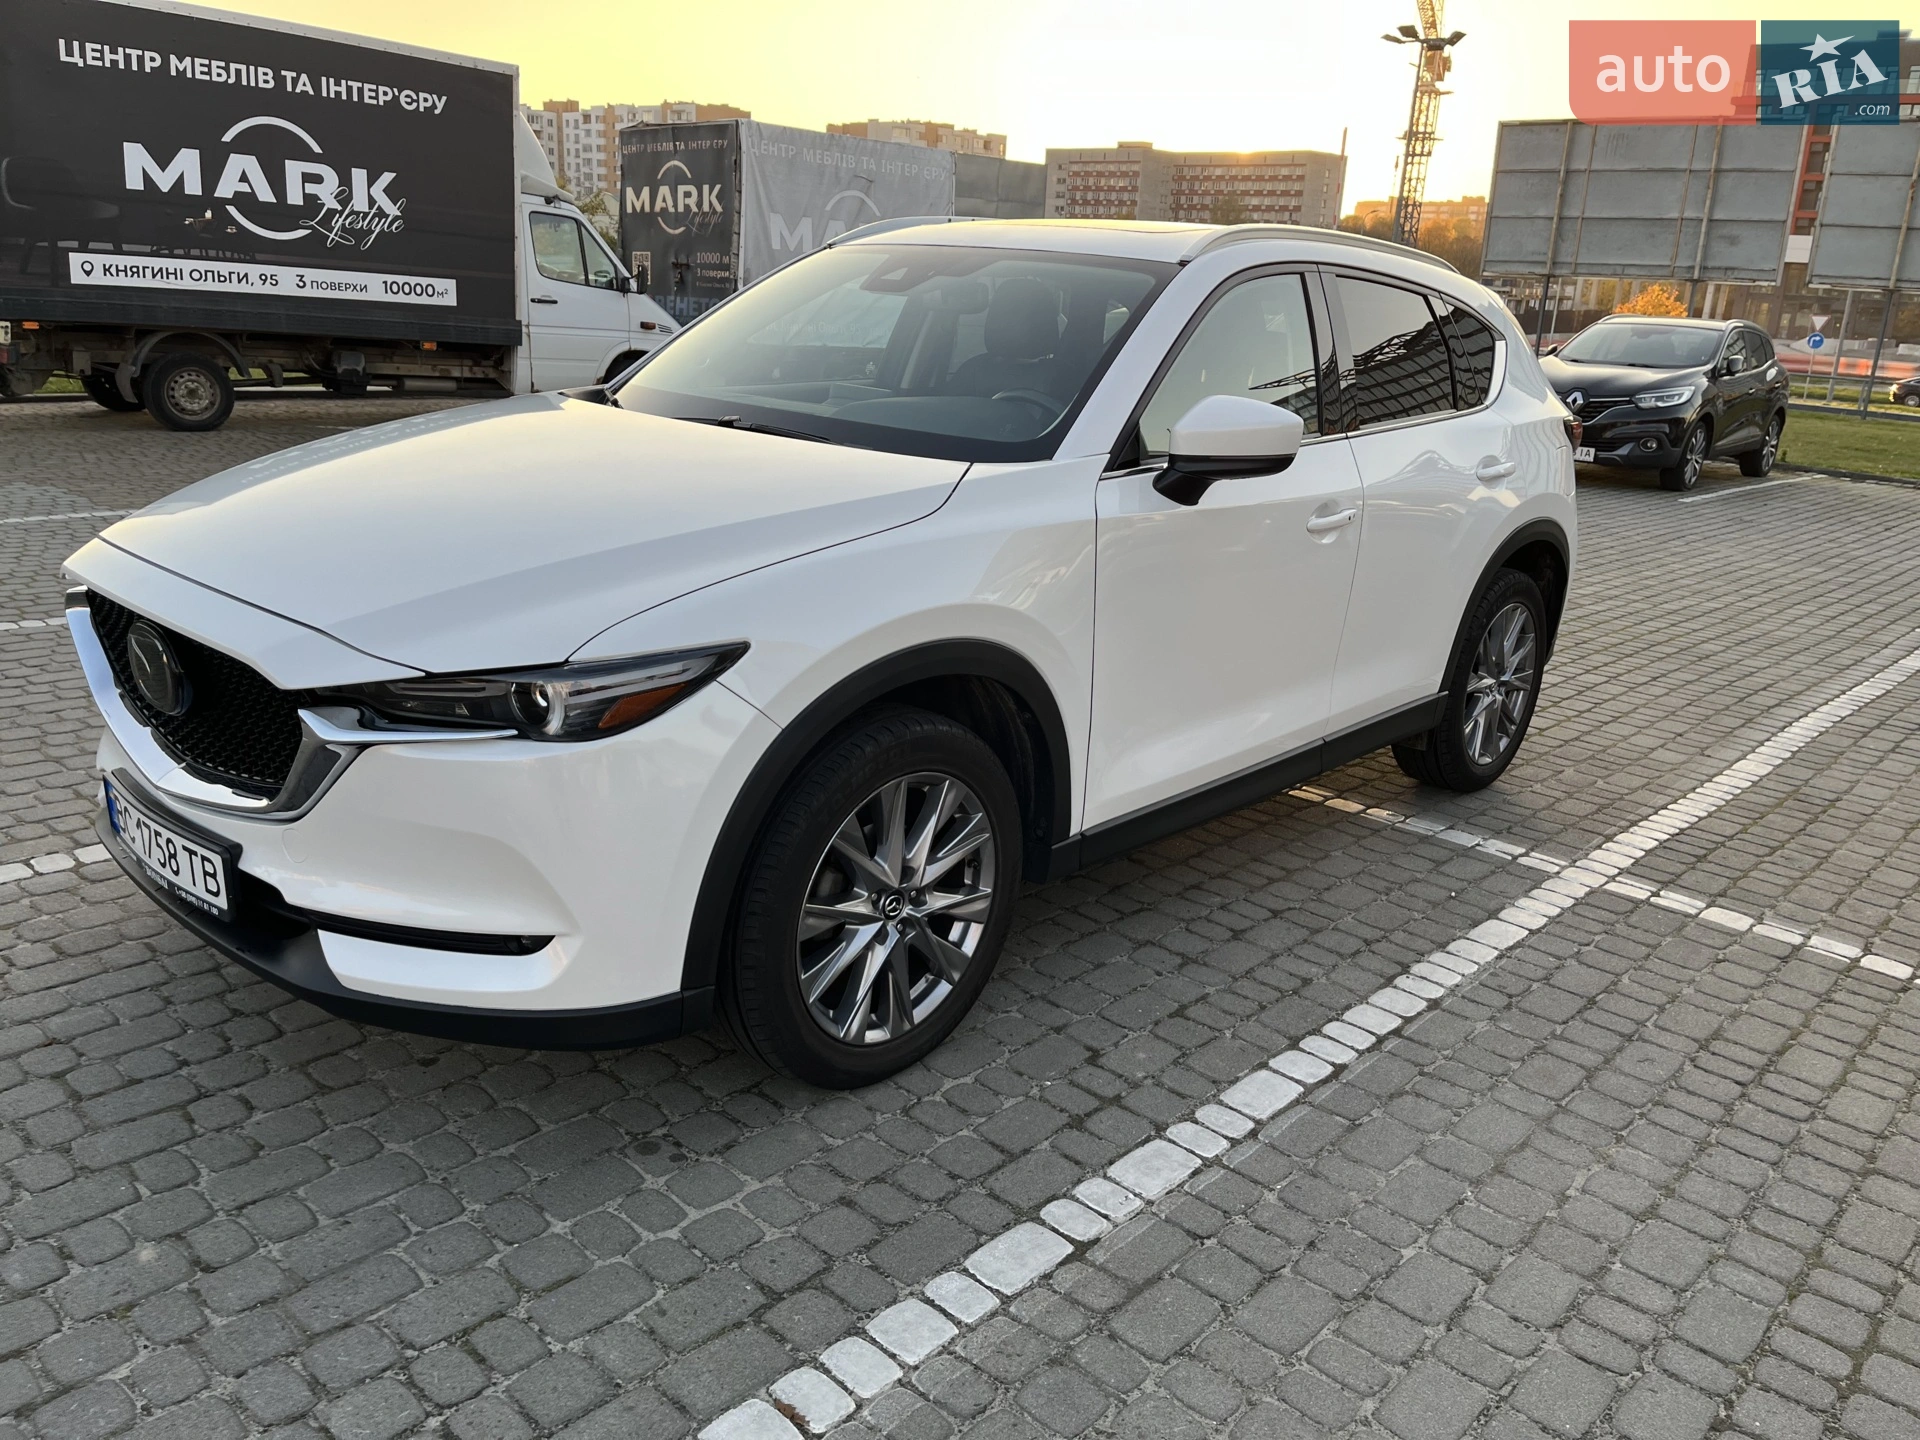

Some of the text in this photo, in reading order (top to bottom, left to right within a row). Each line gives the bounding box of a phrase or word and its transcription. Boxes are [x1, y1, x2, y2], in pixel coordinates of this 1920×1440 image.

[58, 38, 162, 73] ЦЕНТР
[169, 54, 275, 89] МЕБЛІВ
[281, 70, 314, 95] ТА
[675, 141, 685, 150] ТА
[750, 138, 796, 159] ЦЕНТР
[803, 147, 856, 168] МЕБЛІВ
[861, 156, 877, 171] ТА
[122, 141, 401, 216] MARK
[625, 184, 723, 214] MARK
[299, 186, 406, 250] Lifestyle
[769, 212, 866, 252] MA
[696, 252, 721, 264] 10000
[702, 269, 730, 279] поверхи
[102, 263, 184, 281] КНЯГИНІ
[189, 269, 255, 287] ОЛЬГИ,
[259, 273, 279, 287] 95
[295, 274, 307, 289] 3
[311, 280, 368, 293] ПОВЕРХИ
[136, 817, 180, 877] 1758
[181, 844, 221, 898] TB
